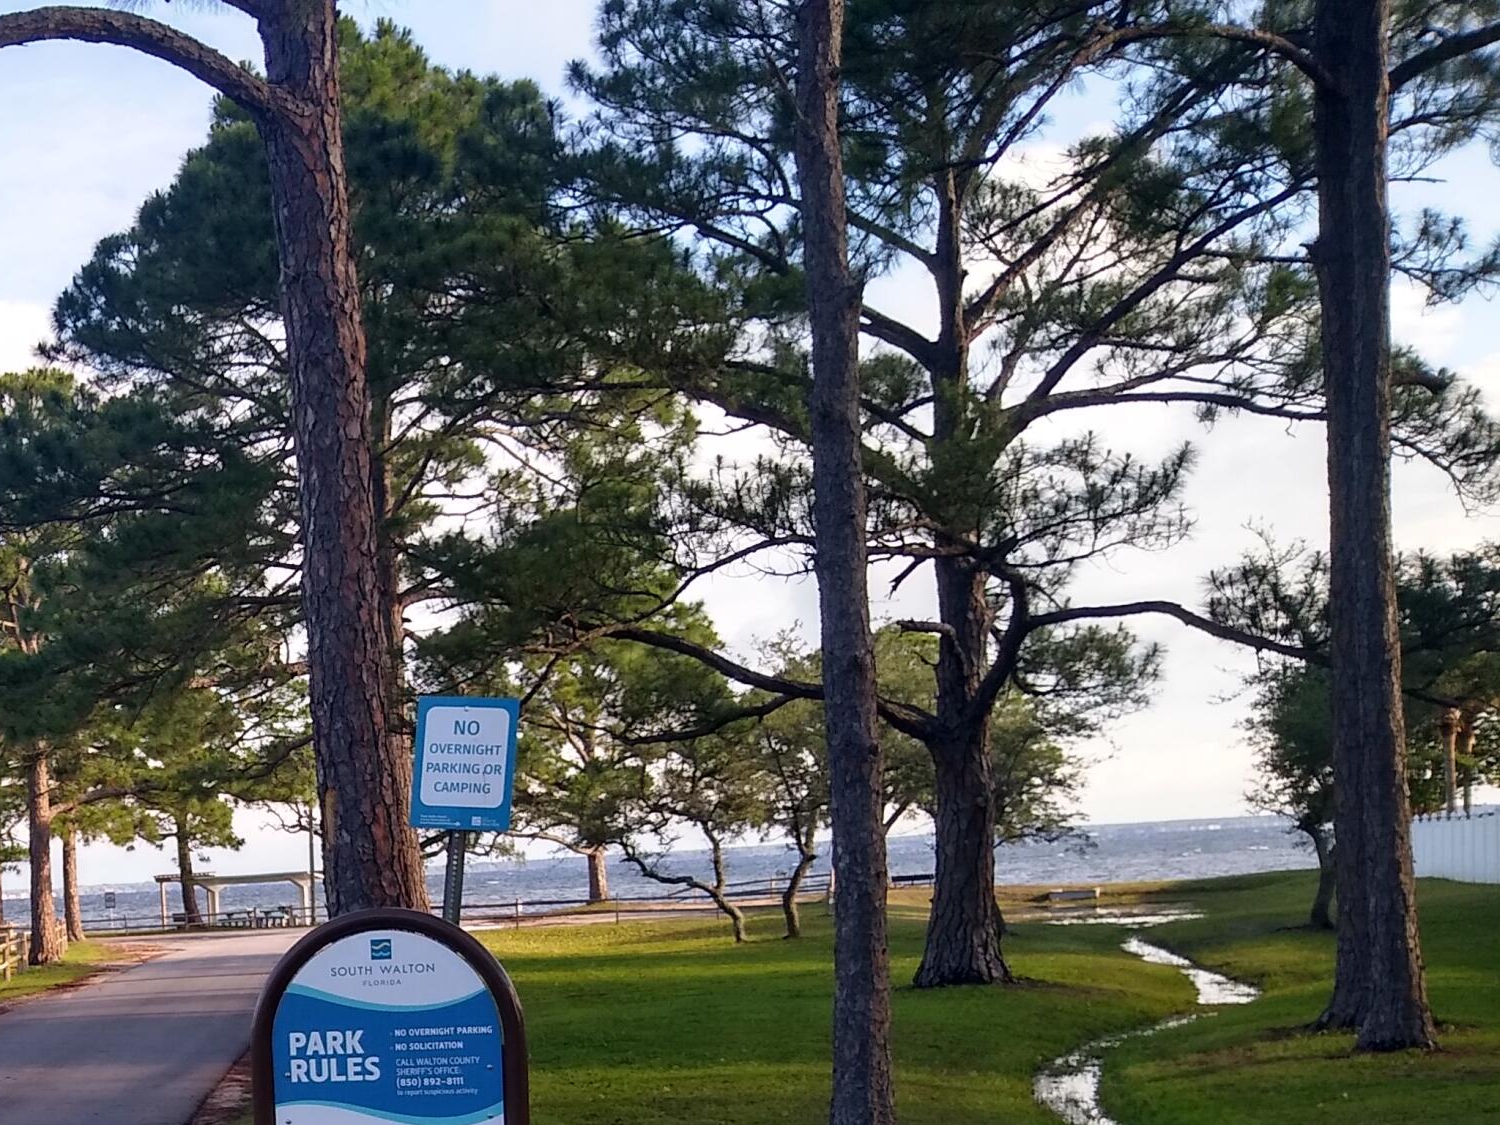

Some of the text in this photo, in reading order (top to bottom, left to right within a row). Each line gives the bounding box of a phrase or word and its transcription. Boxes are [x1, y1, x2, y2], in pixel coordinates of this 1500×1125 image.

[453, 720, 480, 735] NO
[429, 743, 502, 756] OVERNIGHT
[426, 762, 502, 775] PARKING OR
[433, 781, 491, 794] CAMPING
[330, 963, 435, 977] SOUTH WALTON
[362, 979, 402, 987] FLORIDA
[394, 1026, 493, 1037] NO OVERNIGHT PARKING
[289, 1029, 365, 1056] PARK
[394, 1041, 464, 1051] NO SOLICITATION
[395, 1056, 481, 1066] CALL WALTON COUNTY
[290, 1057, 381, 1083] RULES
[396, 1067, 432, 1076] SHERIFF'S
[396, 1076, 464, 1088] (850) 892-8111
[404, 1089, 424, 1097] report
[424, 1088, 455, 1097] suspicious
